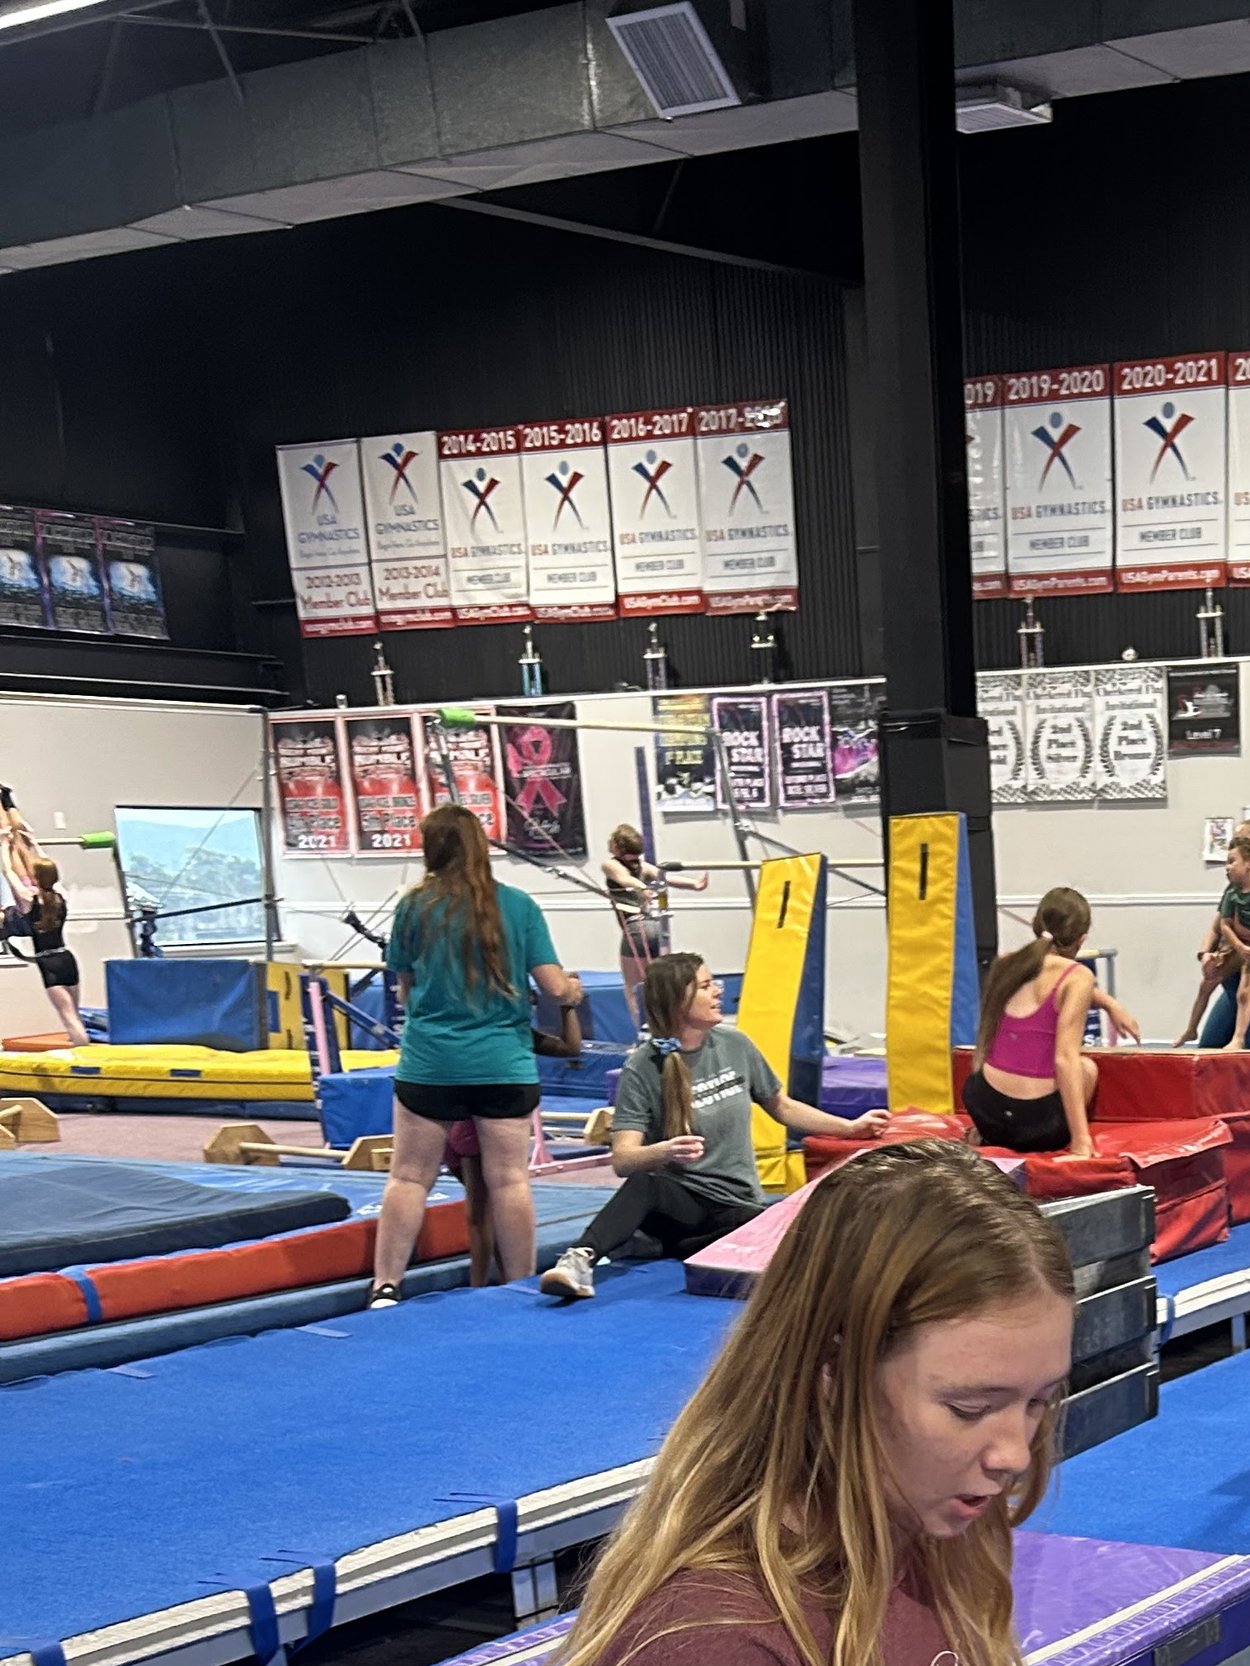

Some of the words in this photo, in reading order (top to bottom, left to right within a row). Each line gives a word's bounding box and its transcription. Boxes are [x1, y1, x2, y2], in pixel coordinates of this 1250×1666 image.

[1121, 359, 1218, 390] 2020-2021
[1008, 369, 1104, 400] 2019-2020
[611, 412, 689, 439] 2016-2017
[441, 430, 517, 455] 2014-2015
[523, 422, 602, 448] 2015-2016
[393, 504, 416, 516] USA
[1122, 498, 1143, 511] USA
[317, 514, 336, 526] USA
[1011, 506, 1032, 520] USA
[375, 519, 439, 535] GYMNASTICS
[298, 528, 360, 544] GYMNASTICS
[619, 533, 637, 545] USA
[706, 529, 725, 542] USA
[1029, 537, 1064, 550] MEMBER
[1067, 535, 1089, 548] CLUB
[1139, 529, 1177, 543] MEMBER
[1179, 527, 1202, 539] CLUB
[451, 547, 468, 558] USA
[531, 544, 549, 556] USA
[305, 573, 362, 589] 2012-2013
[384, 566, 440, 581] 2013-2014
[378, 585, 422, 602] Member
[423, 582, 448, 598] Club
[301, 594, 344, 610] Member
[346, 591, 370, 607] Club
[720, 731, 759, 747] ROCK
[782, 726, 820, 743] ROCK
[1185, 728, 1211, 740] Level
[1212, 728, 1222, 738] 7
[731, 748, 764, 763] STAR
[792, 743, 825, 759] STAR
[297, 834, 336, 849] 2021
[371, 833, 411, 848] 2021
